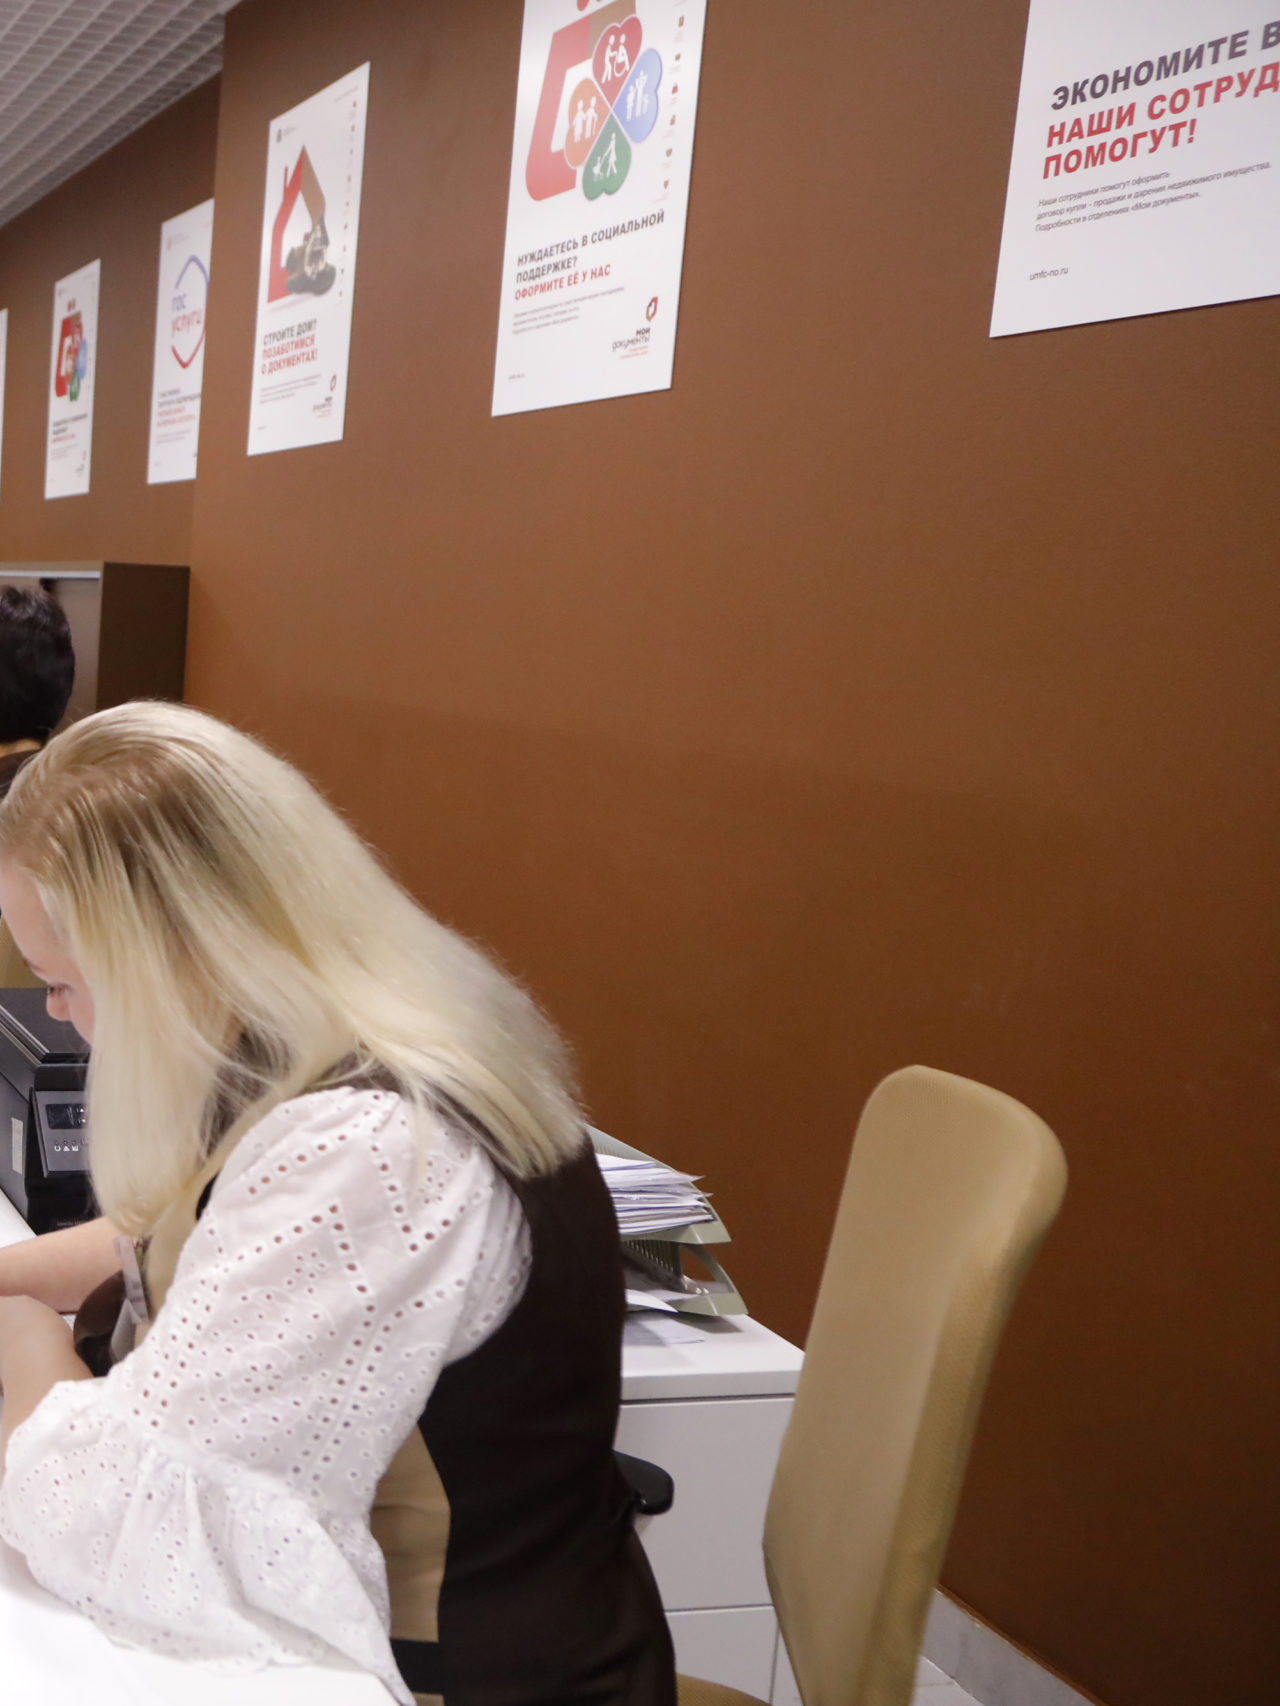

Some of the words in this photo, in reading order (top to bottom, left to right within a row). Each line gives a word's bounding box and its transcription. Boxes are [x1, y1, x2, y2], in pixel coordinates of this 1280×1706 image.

[1051, 30, 1249, 110] ЭКОНОМИТЕ
[1047, 102, 1136, 148] НАШИ
[1147, 61, 1280, 120] СОТРУД
[1043, 118, 1197, 180] ПОМОГУТ!
[517, 237, 578, 267] НУЖДАЕТЕСЬ
[581, 234, 588, 247] В
[591, 209, 665, 244] СОЦИАЛЬНОЙ
[515, 278, 564, 301] ОФОРМИТЕ
[582, 269, 587, 283] У
[590, 264, 611, 280] НАС
[516, 256, 578, 284] ПОДДЕРЖКЕ?
[263, 326, 295, 346] СТРОИТЕ
